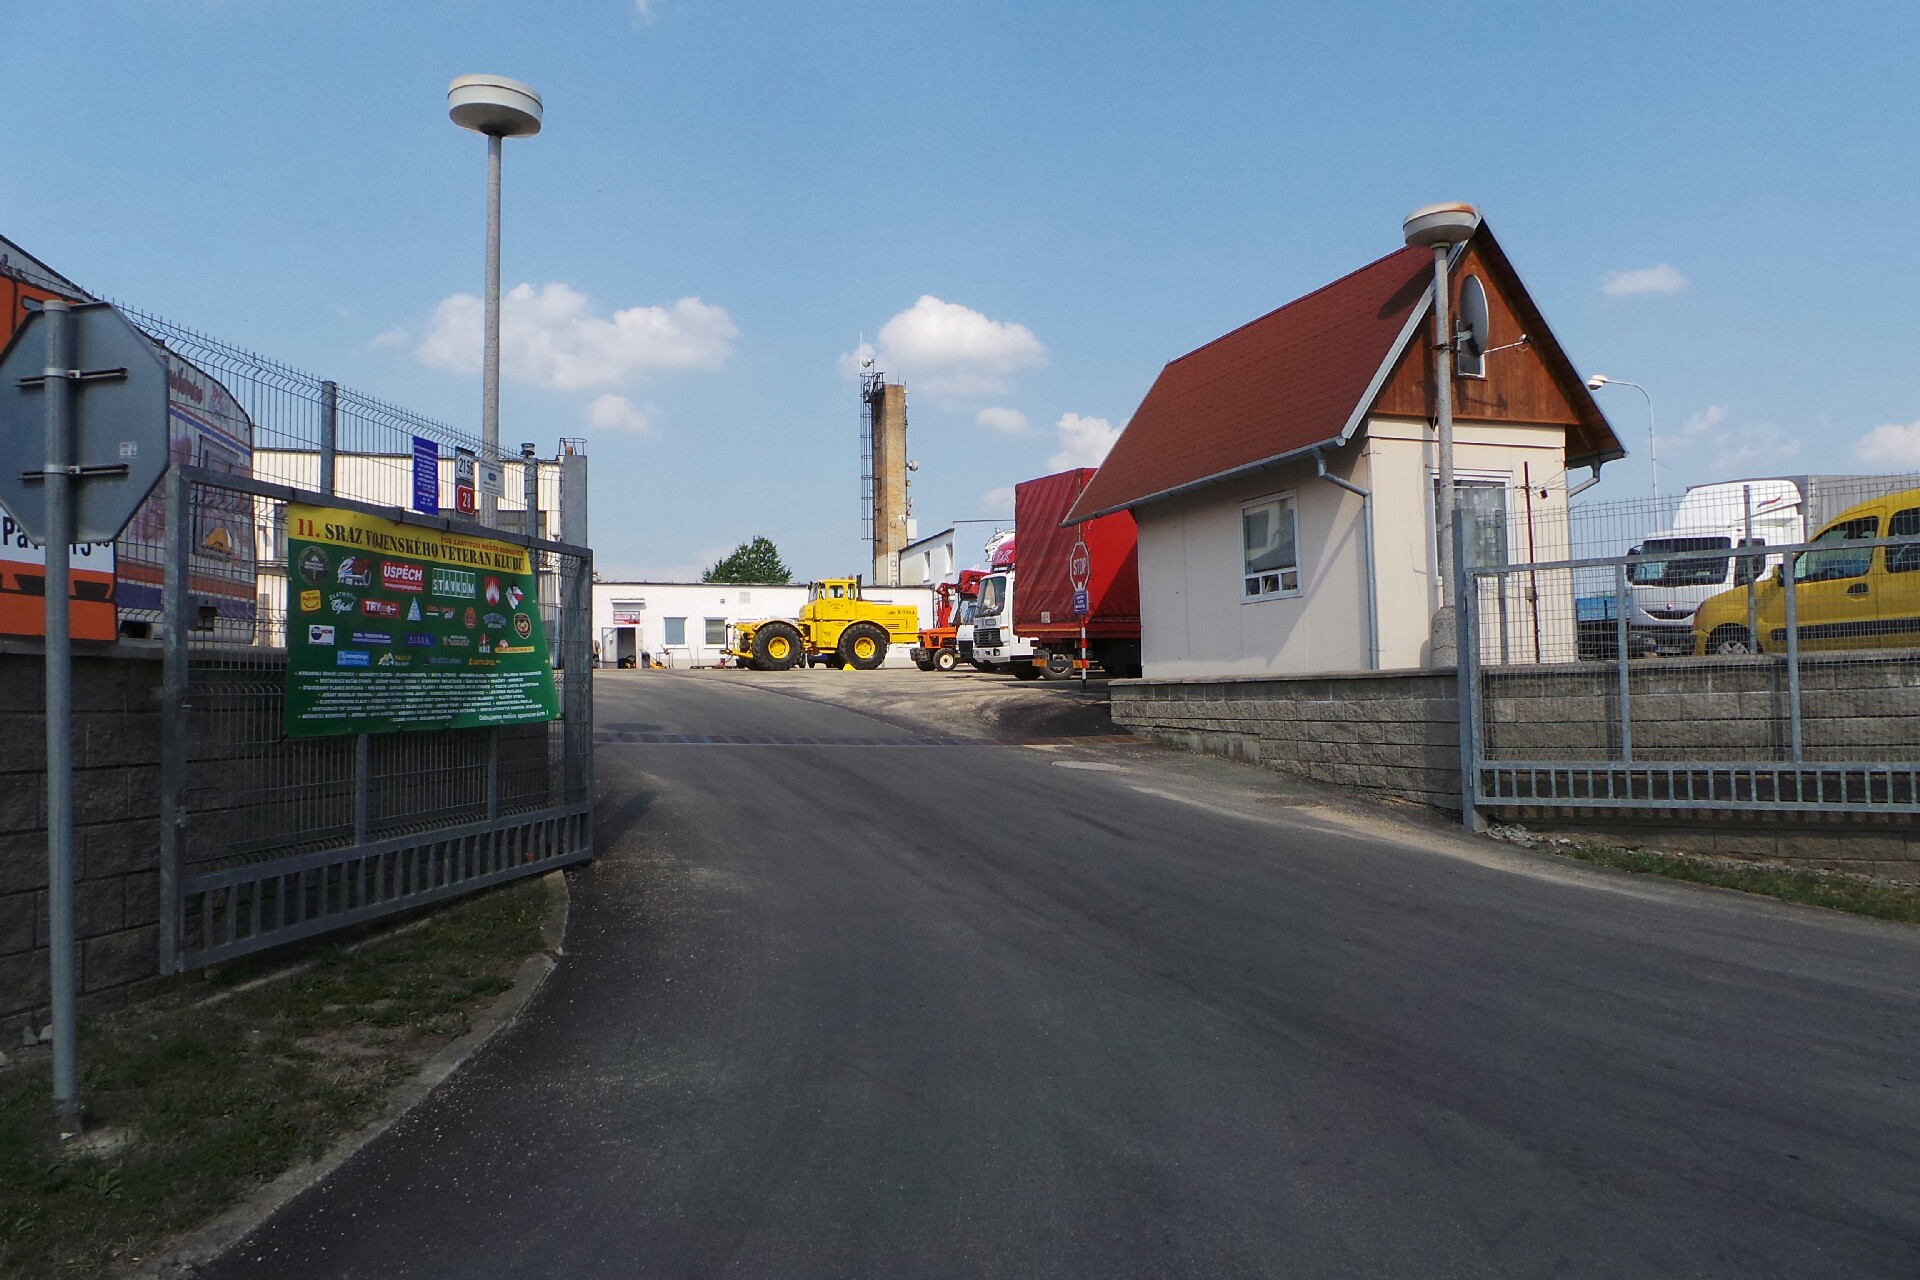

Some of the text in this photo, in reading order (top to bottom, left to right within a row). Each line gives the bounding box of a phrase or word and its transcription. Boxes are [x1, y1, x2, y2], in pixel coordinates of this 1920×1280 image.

[297, 518, 525, 572] 11. SRAZ VOJENSKÉHO VETERAN KLUBU
[383, 562, 423, 581] ÚSPĚCH
[1073, 557, 1087, 577] STOP
[433, 580, 475, 594] STAVKOM
